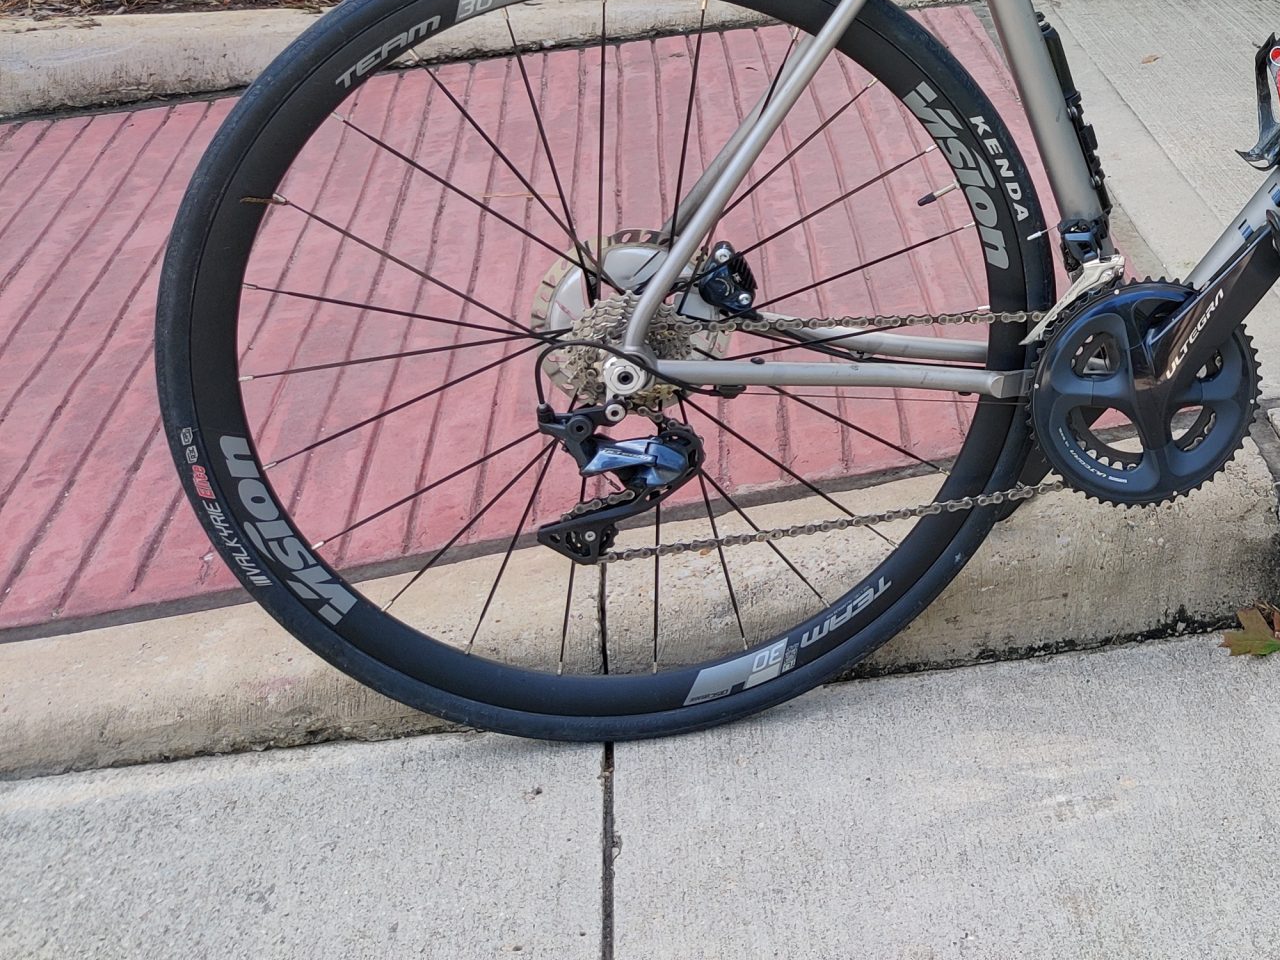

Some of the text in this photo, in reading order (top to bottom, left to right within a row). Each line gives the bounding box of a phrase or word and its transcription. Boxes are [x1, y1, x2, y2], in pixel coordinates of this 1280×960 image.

[335, 15, 441, 89] TEAM
[969, 115, 1029, 222] KENDA
[202, 499, 261, 577] VALKYRIE
[800, 576, 892, 649] TEAM
[752, 644, 784, 672] 30
